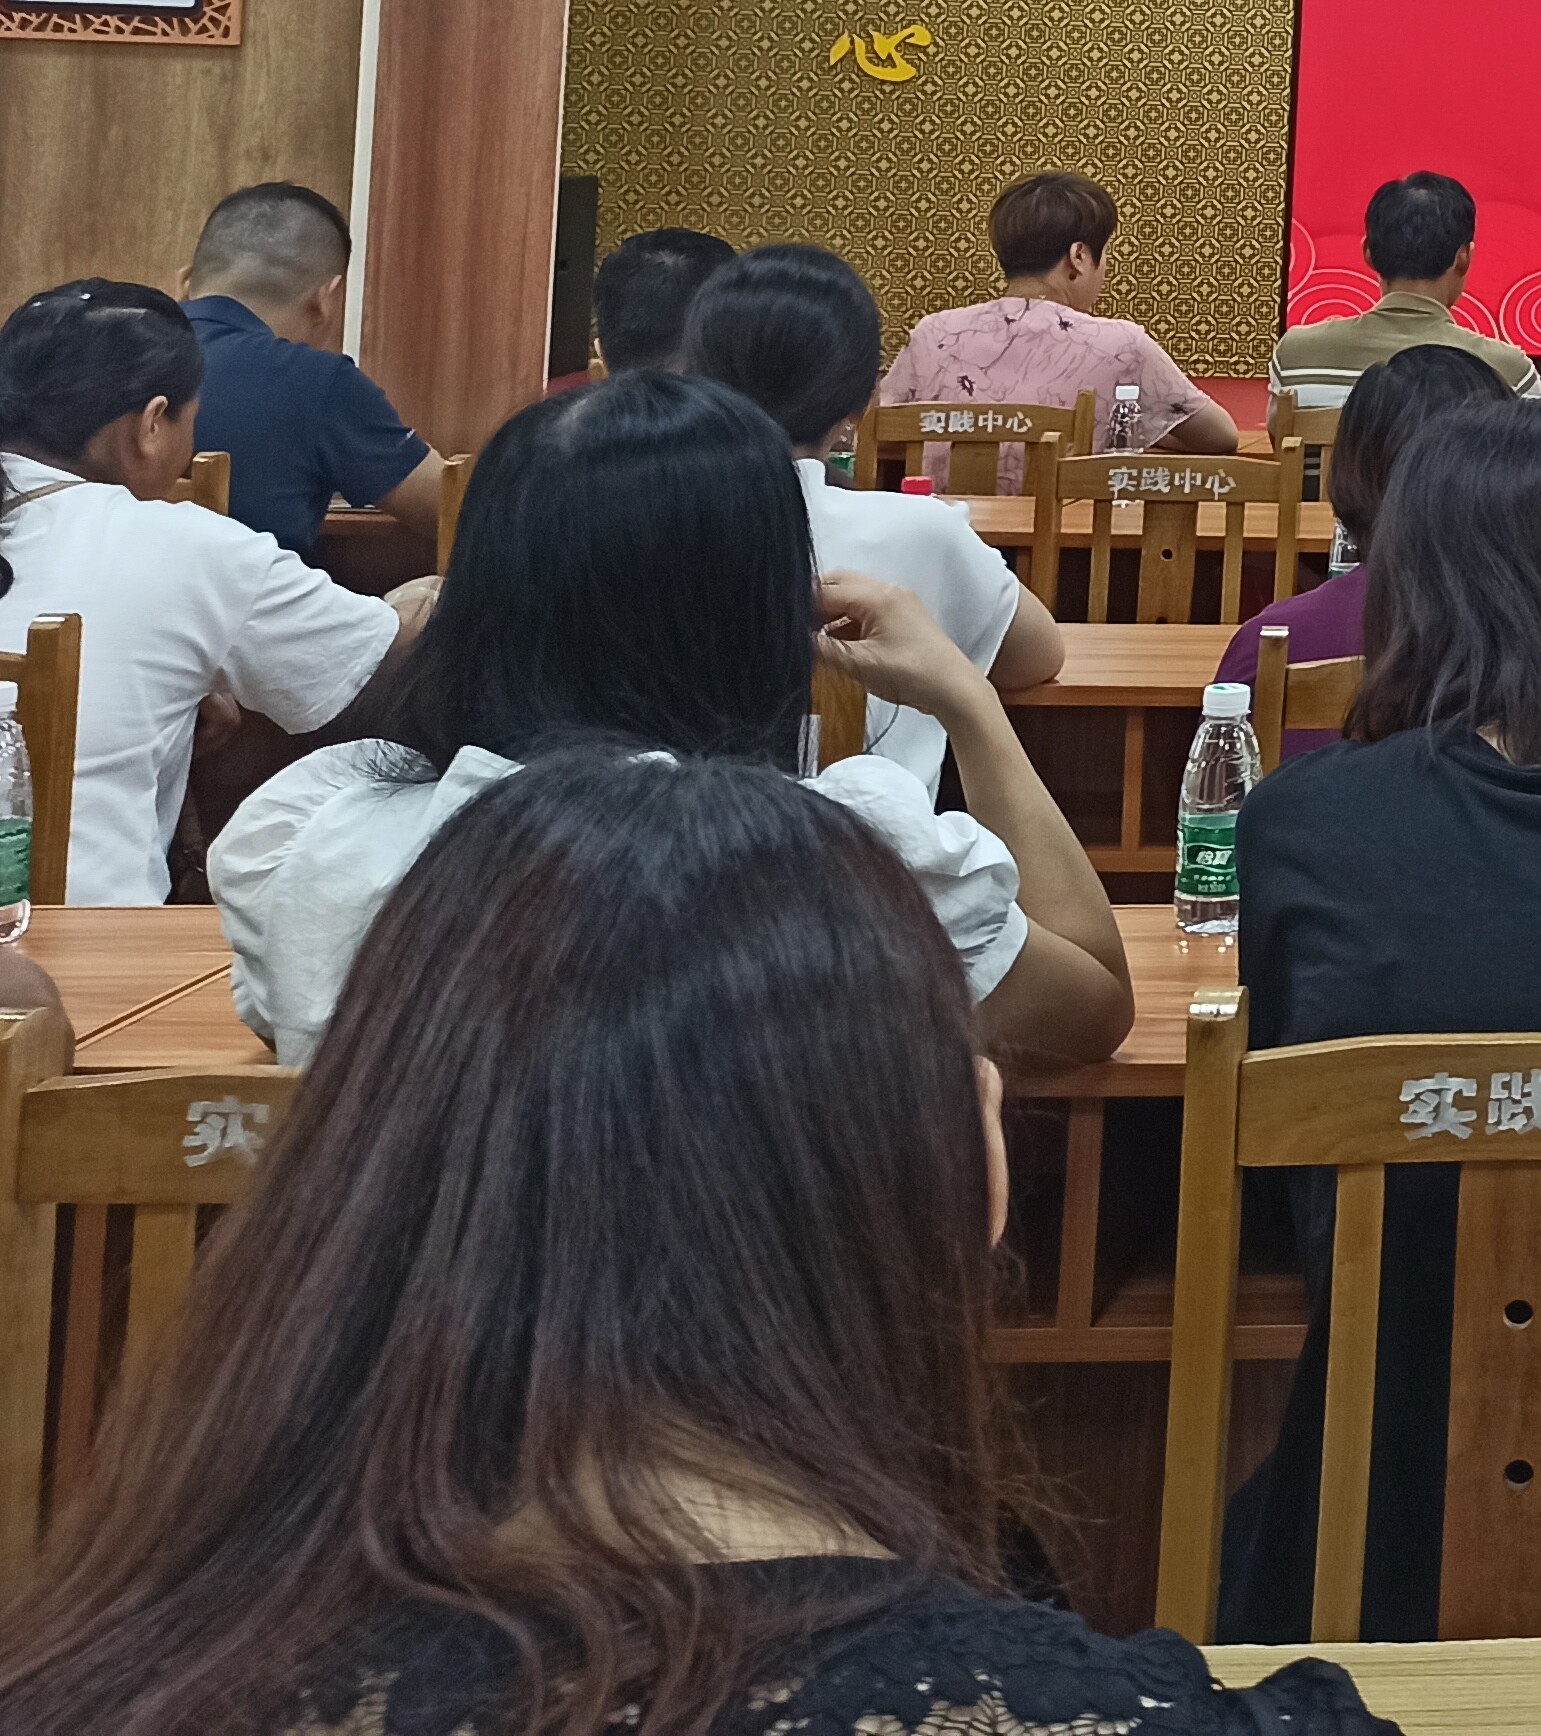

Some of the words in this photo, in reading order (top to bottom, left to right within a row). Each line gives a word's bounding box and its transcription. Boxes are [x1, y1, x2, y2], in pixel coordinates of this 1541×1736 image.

[919, 410, 1033, 434] 实践中心
[1107, 466, 1238, 504] 实践中心
